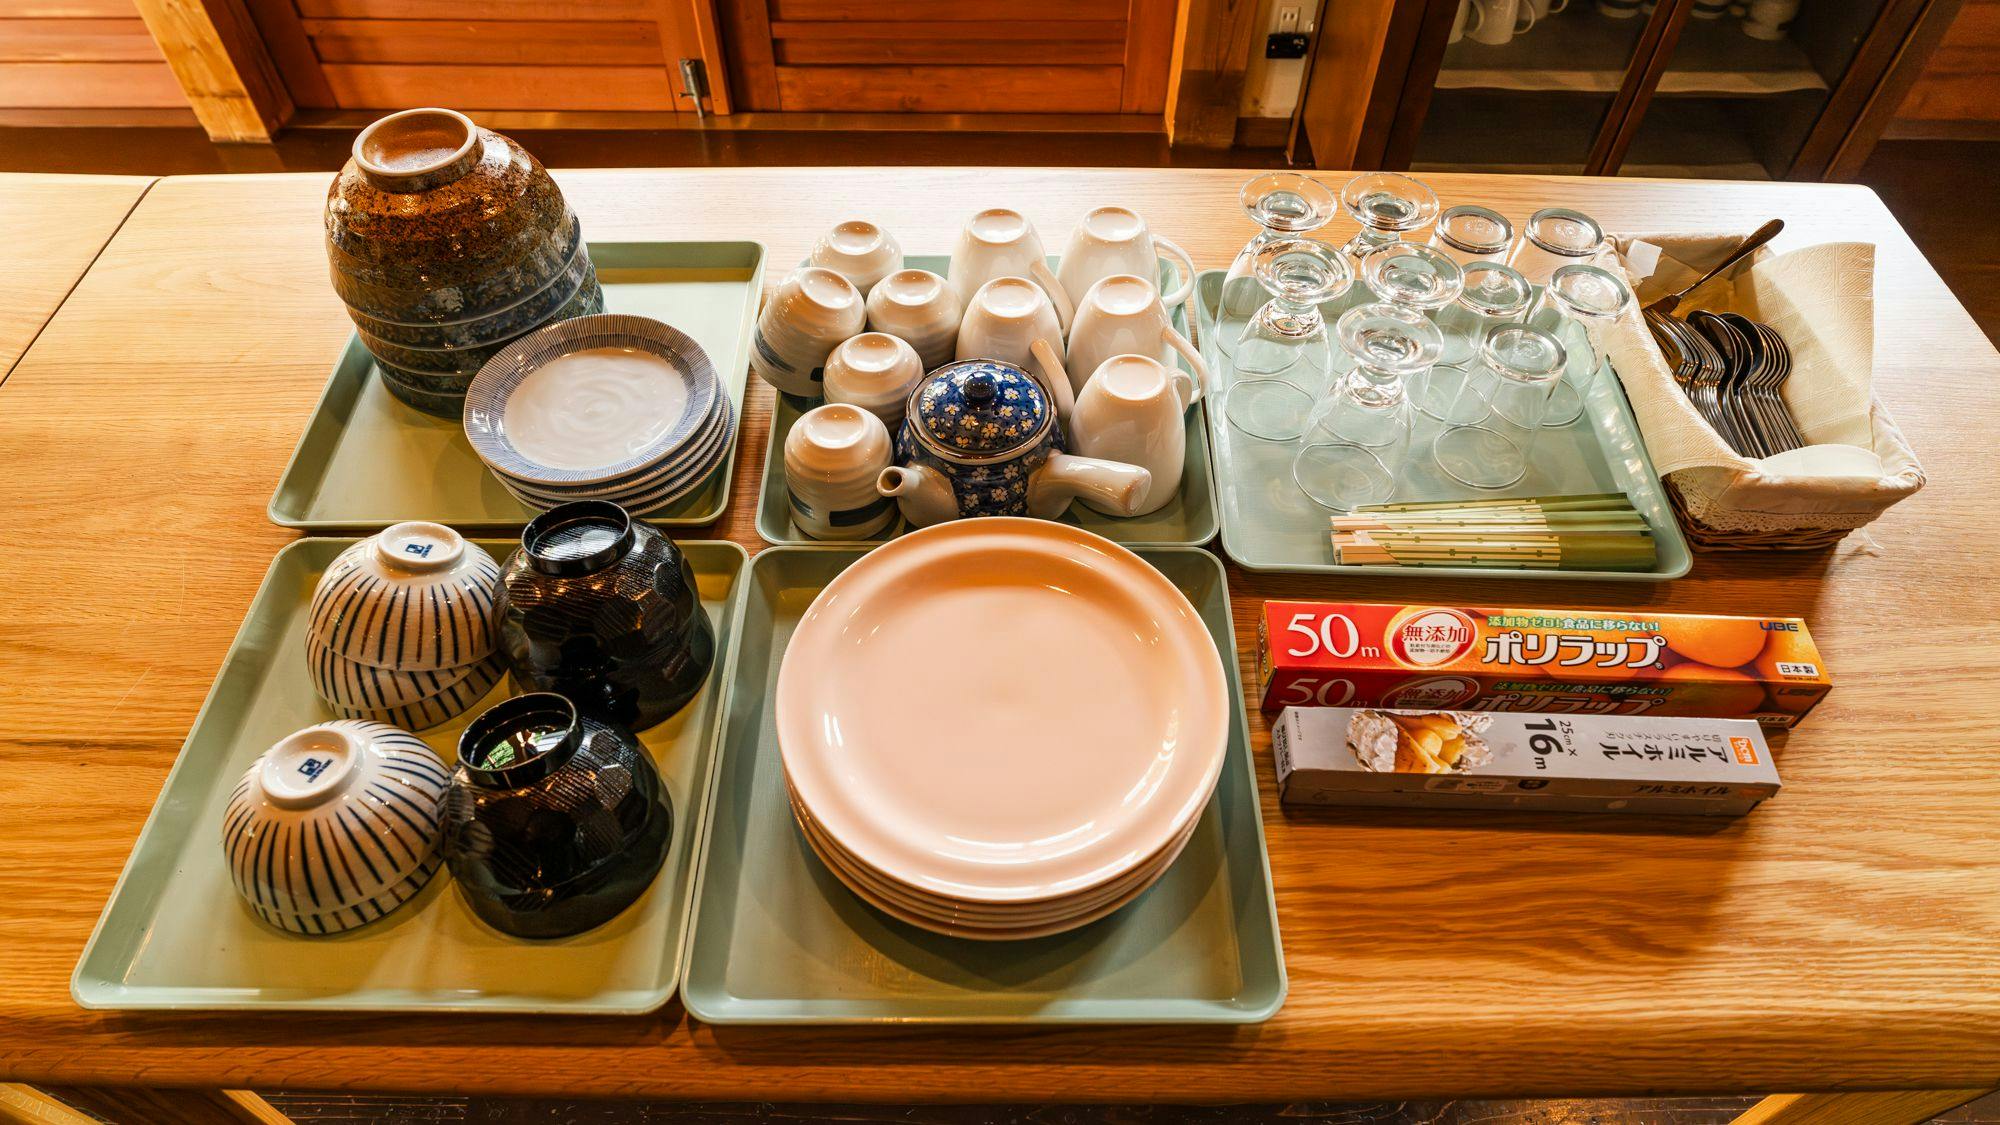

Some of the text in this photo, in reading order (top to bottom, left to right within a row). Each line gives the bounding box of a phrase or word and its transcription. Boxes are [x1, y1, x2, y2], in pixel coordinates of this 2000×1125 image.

[1403, 626, 1469, 643] 無添加
[1759, 621, 1799, 632] UBE
[1481, 630, 1668, 668] ポリラップ
[1780, 664, 1815, 674] 日本製
[1599, 742, 1729, 763] アルミホイル
